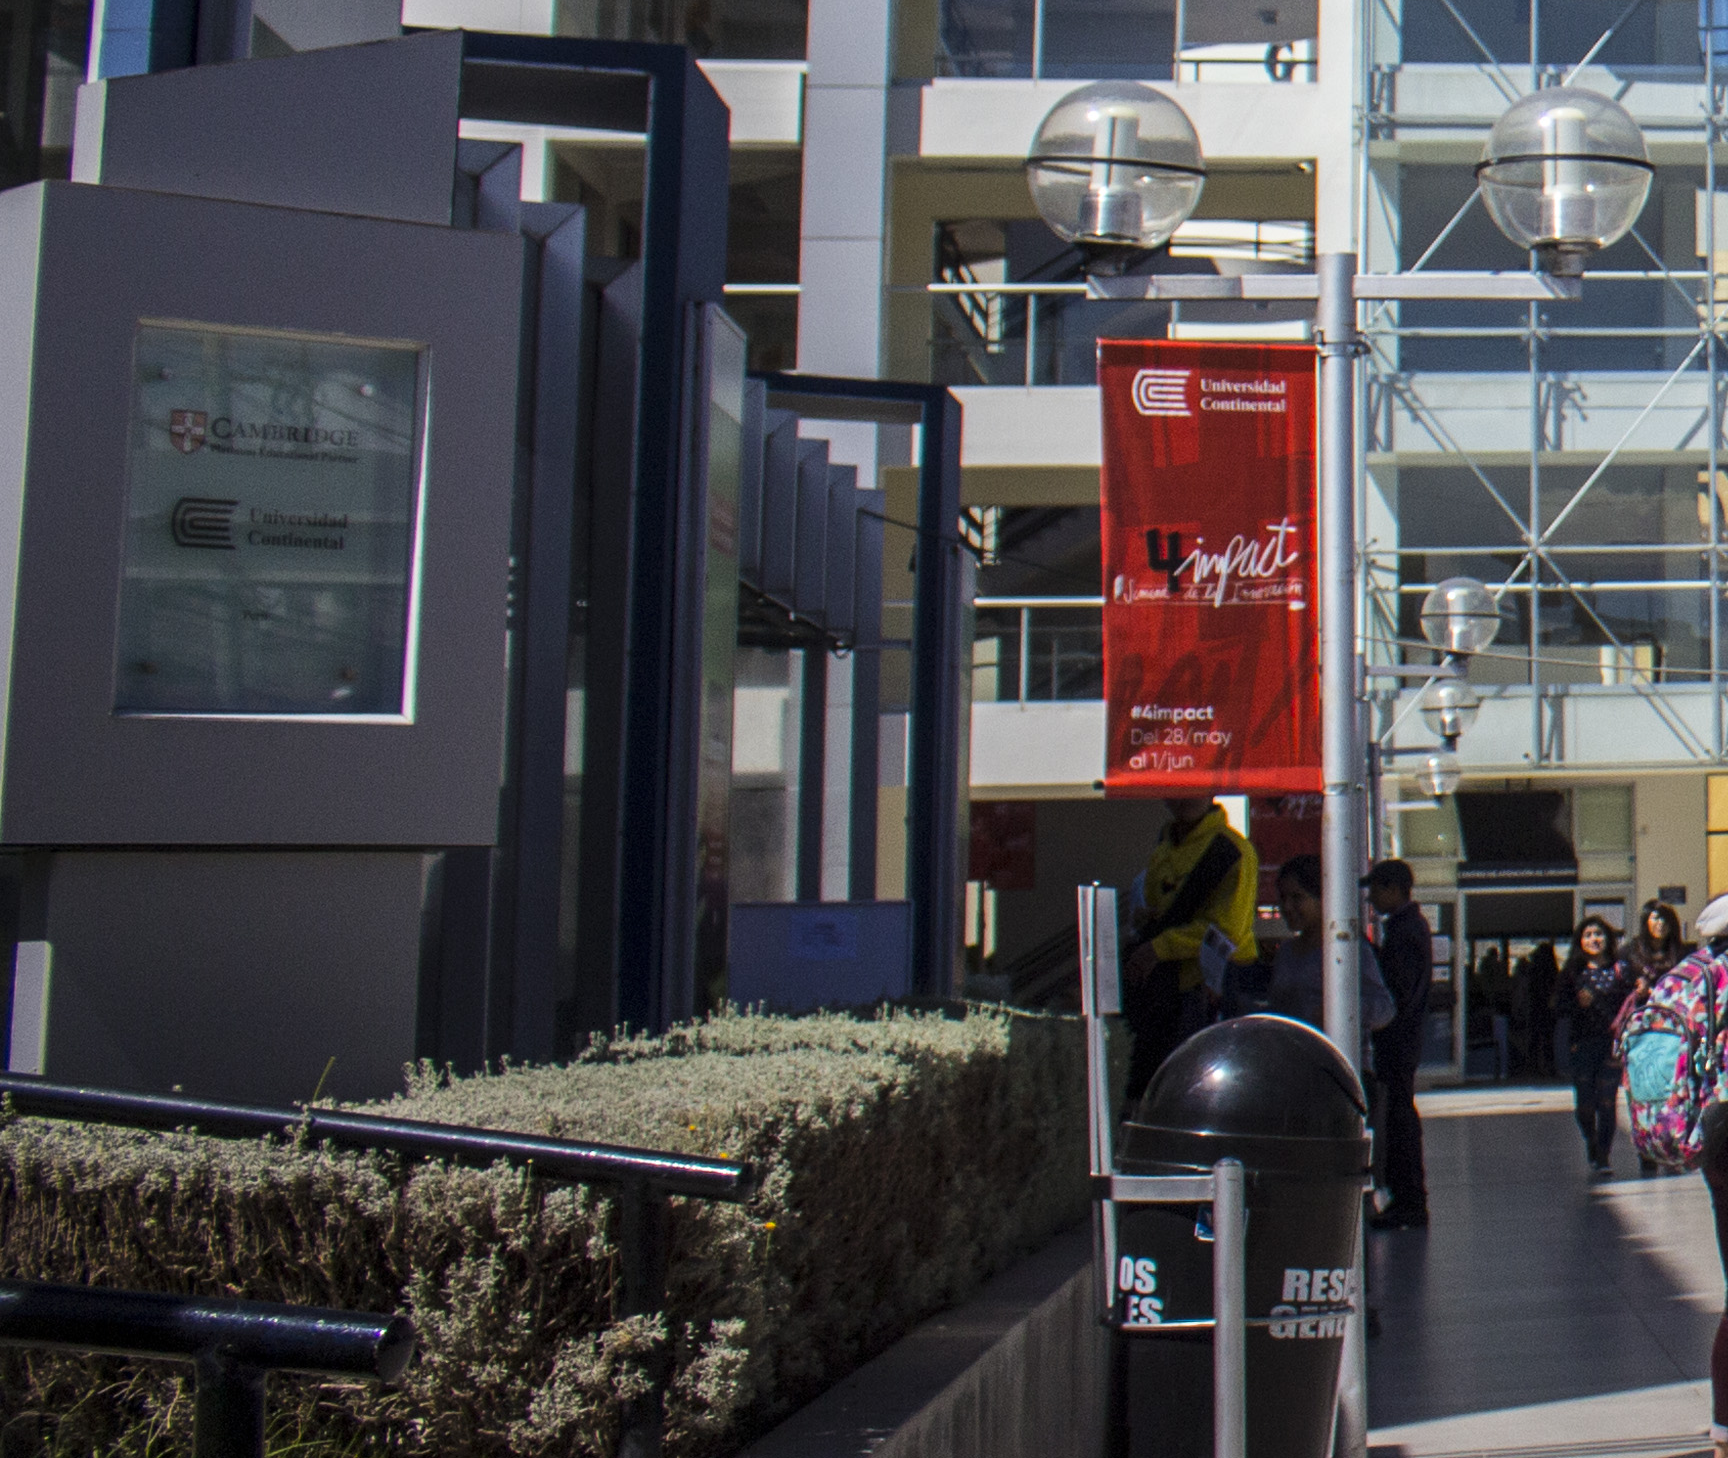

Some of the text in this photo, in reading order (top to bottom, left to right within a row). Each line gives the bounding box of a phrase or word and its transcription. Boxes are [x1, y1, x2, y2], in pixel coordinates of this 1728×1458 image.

[1200, 378, 1286, 394] Universidad
[1200, 397, 1286, 413] Continental
[211, 416, 360, 447] CAMBRIDGE
[250, 506, 348, 529] Universidad
[249, 529, 345, 550] Continental
[1130, 704, 1215, 724] #4impact
[1131, 727, 1233, 748] Del 28/may
[1129, 750, 1195, 773] al 1/jun
